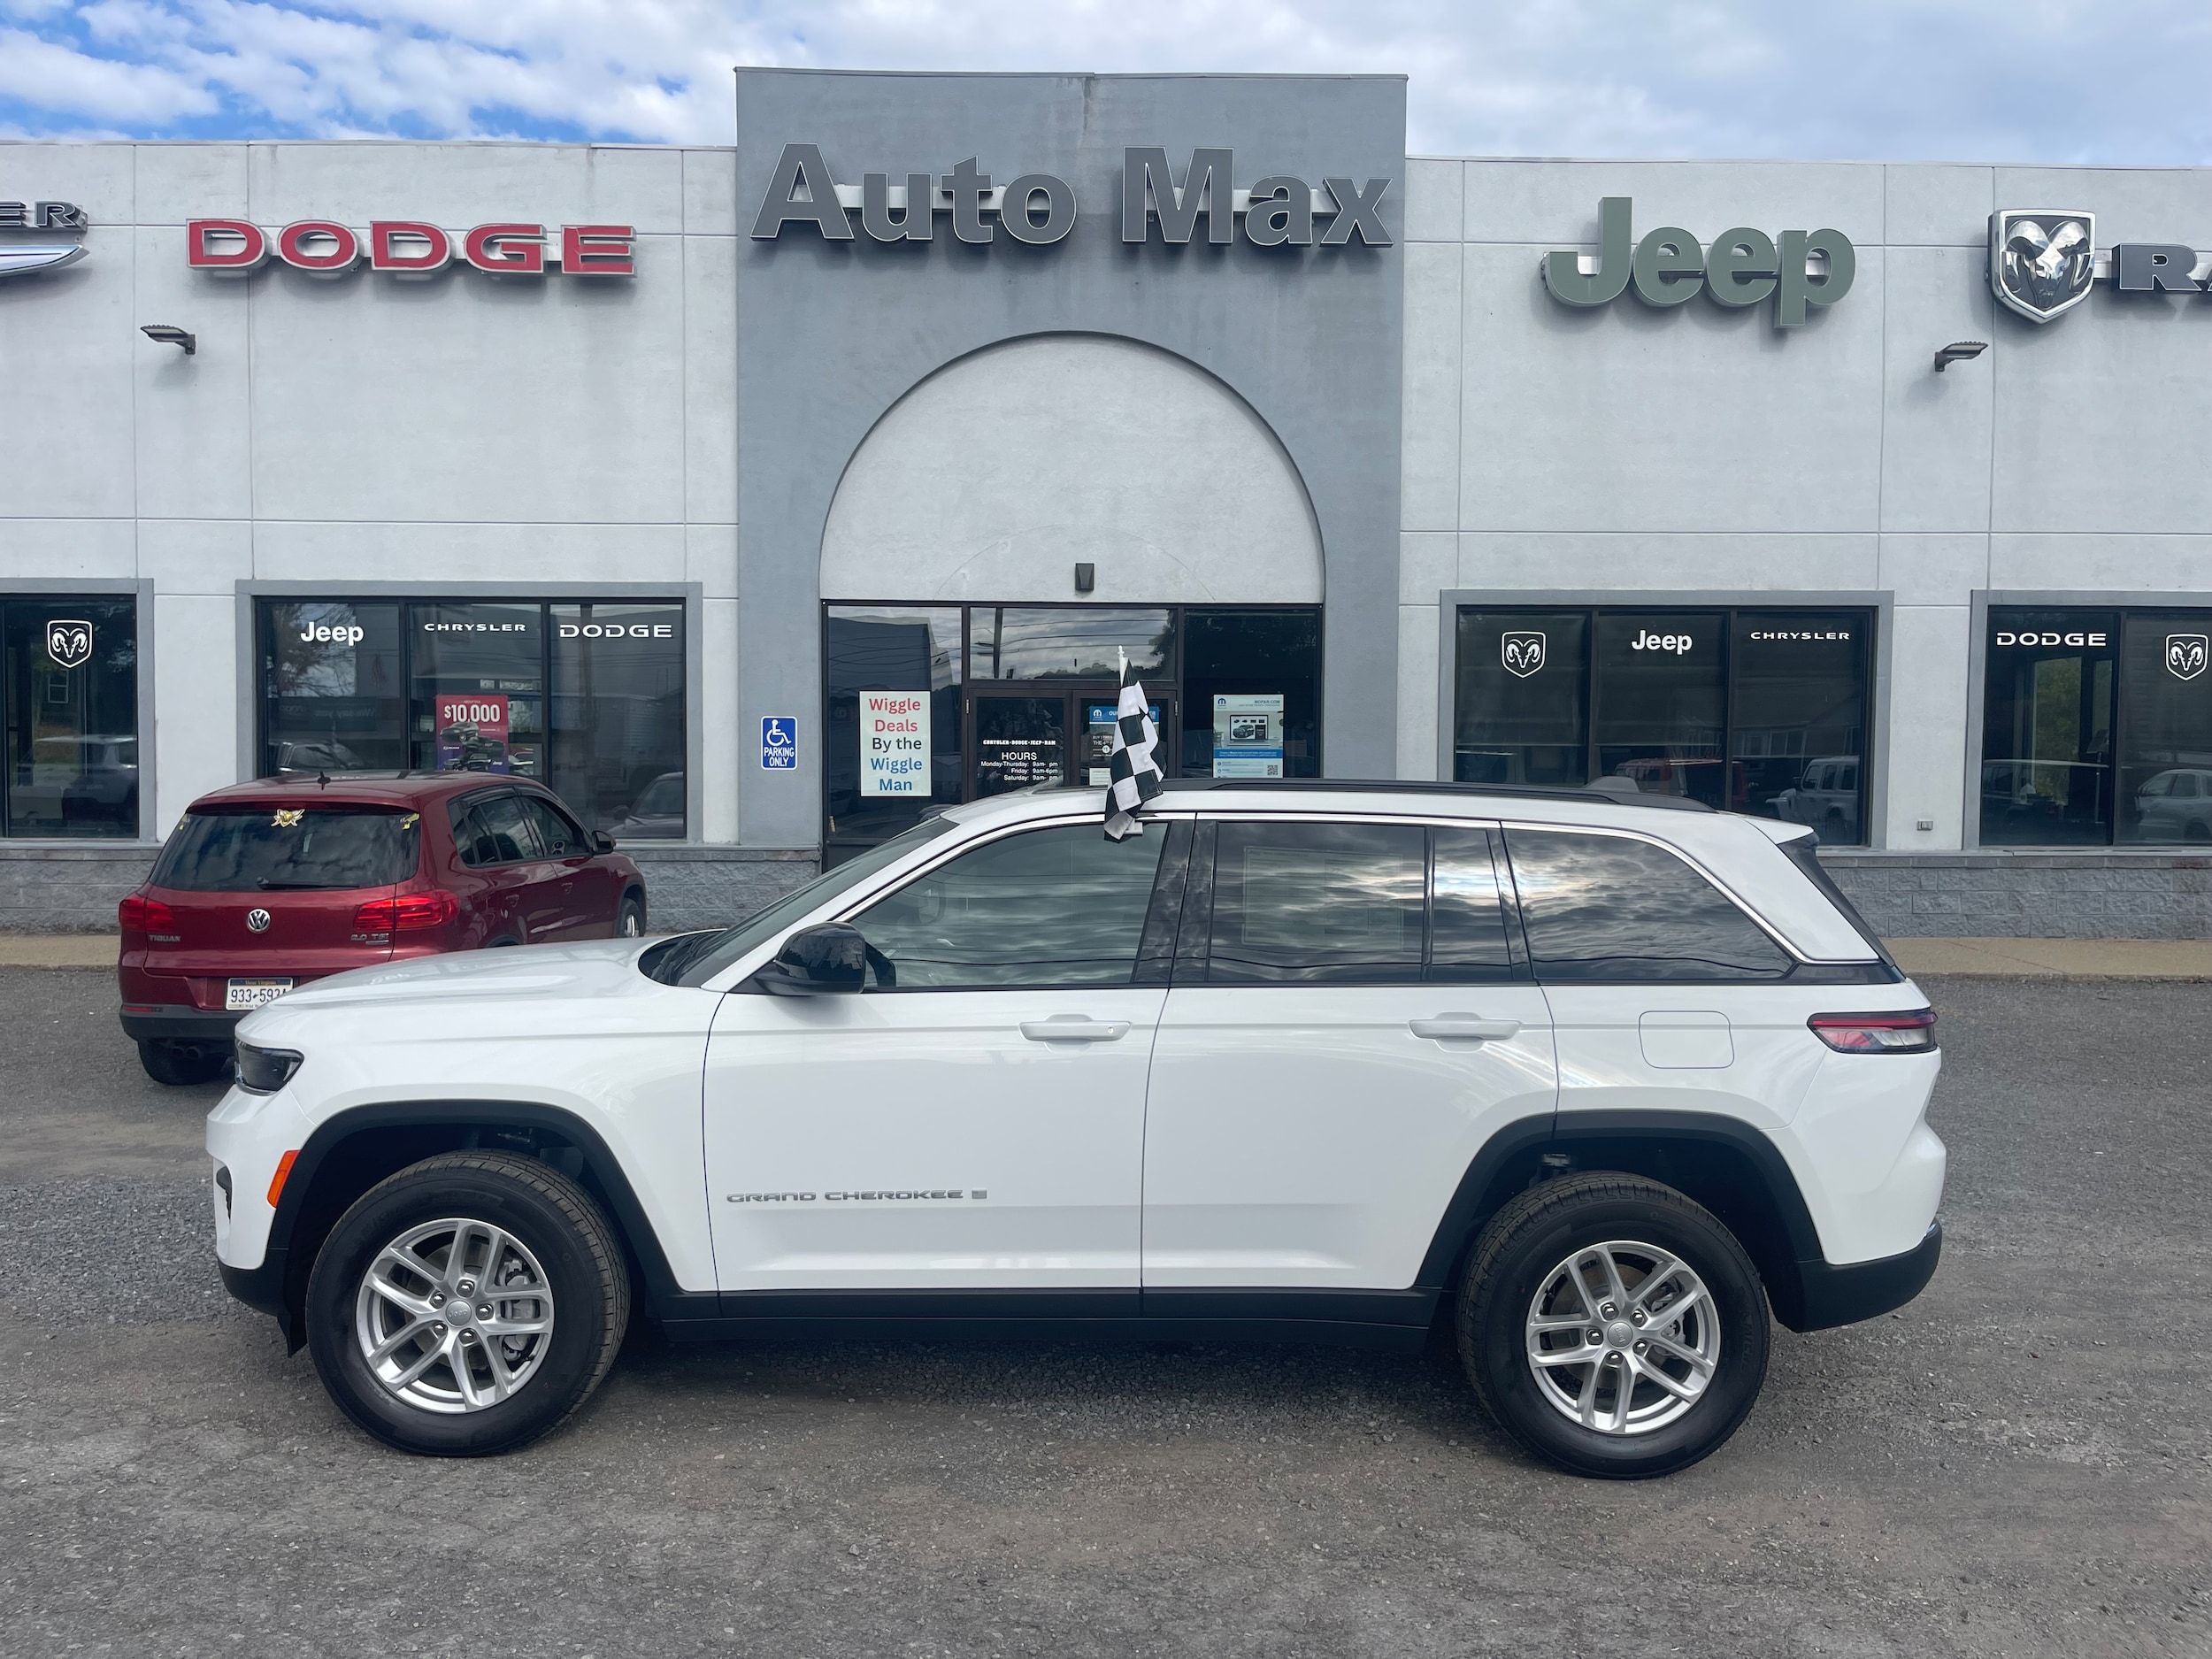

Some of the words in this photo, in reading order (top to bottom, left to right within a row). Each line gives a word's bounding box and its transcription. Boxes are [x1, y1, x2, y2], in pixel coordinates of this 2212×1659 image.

[750, 142, 1077, 245] Auto
[1122, 146, 1395, 248] Max
[187, 219, 638, 276] DODGE
[1543, 196, 1856, 328] Jeep
[300, 621, 364, 646] Jeep
[424, 623, 526, 632] CHRYSLER
[559, 624, 672, 638] DODGE
[1632, 629, 1693, 655] Jeep
[1750, 631, 1850, 640] CHRYSLER
[1996, 632, 2107, 646] DODGE
[869, 698, 921, 714] Wiggle
[444, 704, 501, 723] $10,000
[875, 719, 918, 732] Deals
[764, 747, 795, 757] PARKING
[872, 737, 892, 753] By
[895, 737, 922, 749] the
[769, 757, 789, 767] ONLY
[1001, 752, 1038, 761] HOURS
[871, 757, 922, 773] Wiggle
[879, 779, 912, 790] Man
[726, 1192, 817, 1203] GRAND
[824, 1189, 964, 1201] CHEROKEE
